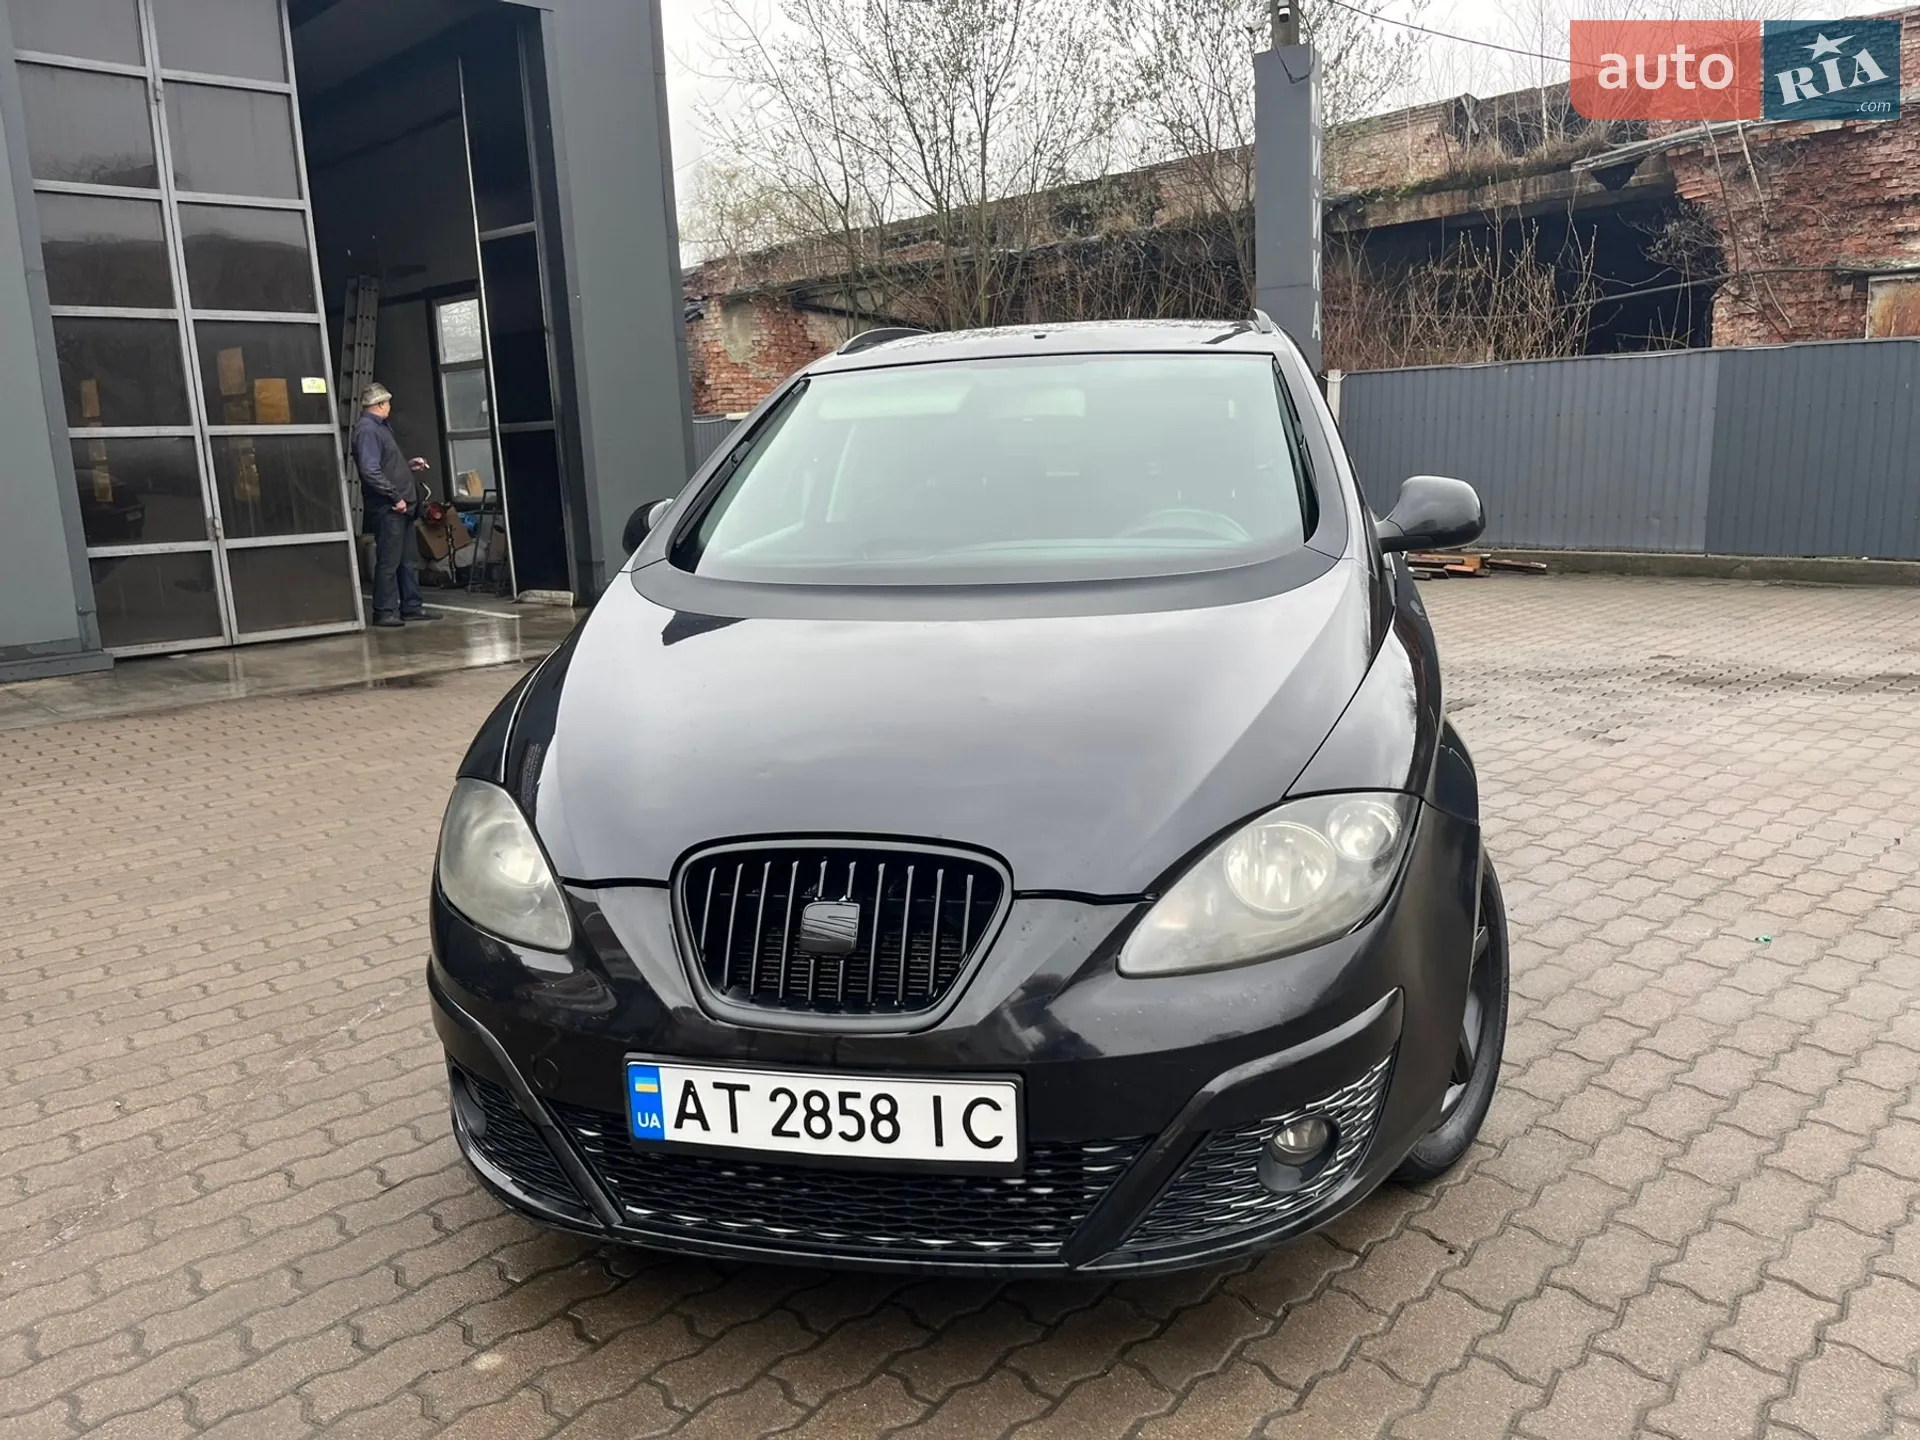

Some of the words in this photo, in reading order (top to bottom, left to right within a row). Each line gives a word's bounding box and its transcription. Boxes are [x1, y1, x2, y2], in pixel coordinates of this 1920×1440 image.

[1311, 81, 1321, 341] МИЙКА
[637, 1112, 661, 1129] UA
[674, 1079, 750, 1134] AT
[769, 1087, 901, 1144] 2858
[933, 1095, 1003, 1149] IC
